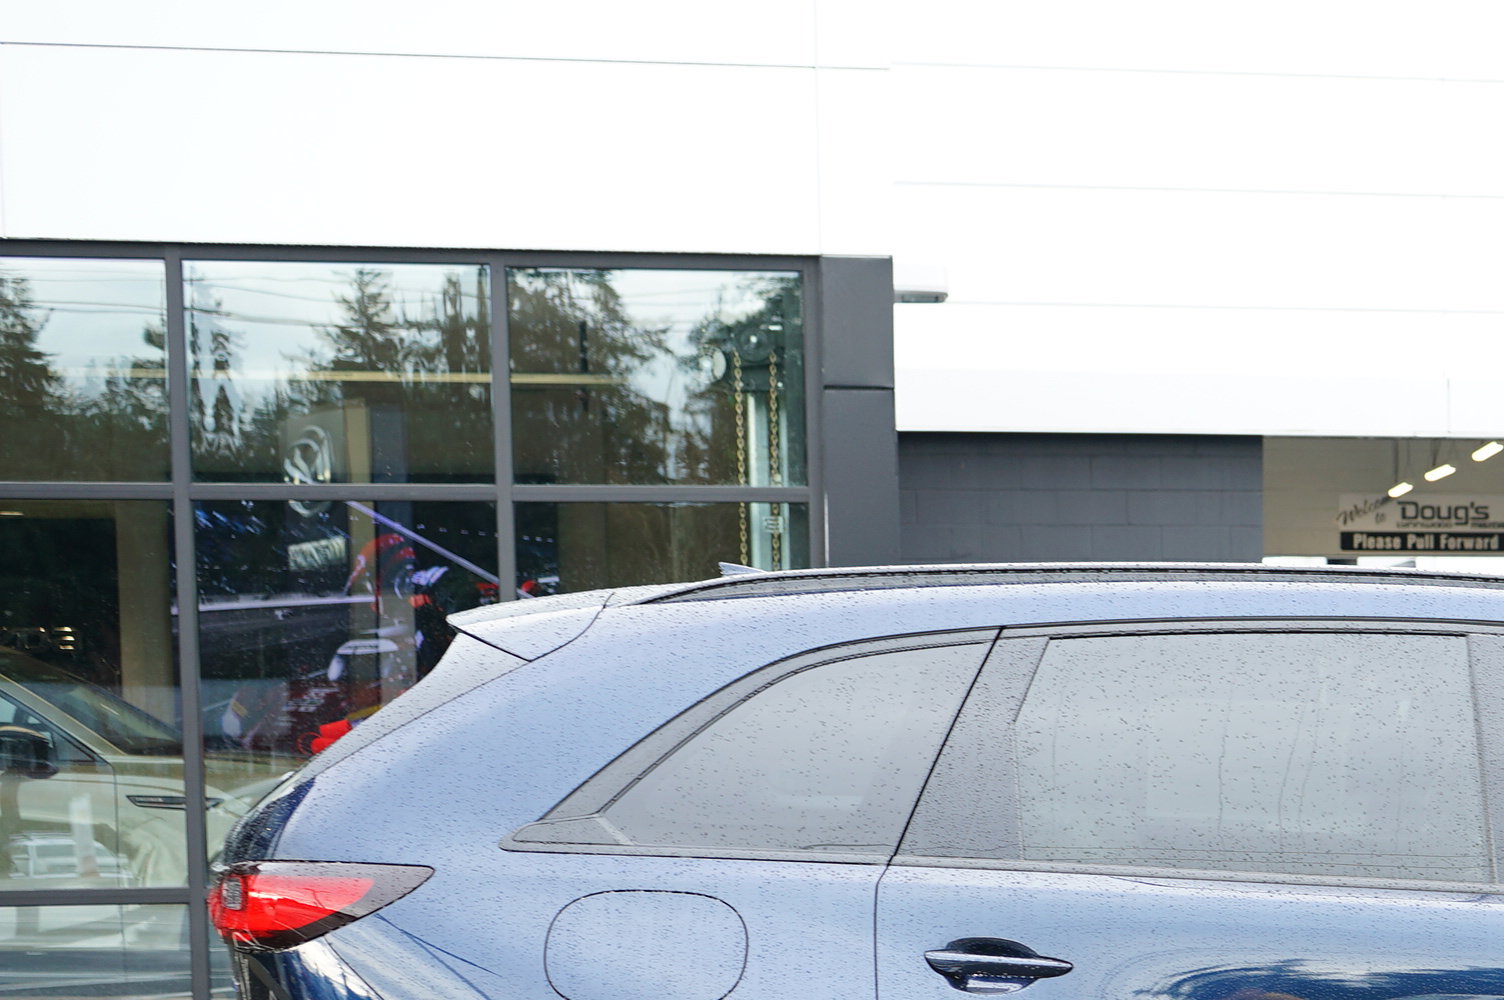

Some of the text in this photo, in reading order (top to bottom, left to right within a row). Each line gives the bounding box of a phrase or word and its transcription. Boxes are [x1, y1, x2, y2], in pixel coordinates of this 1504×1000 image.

[1336, 496, 1389, 526] Welco
[1396, 500, 1490, 526] Doug's
[1353, 533, 1499, 550] Please Pull Forward
